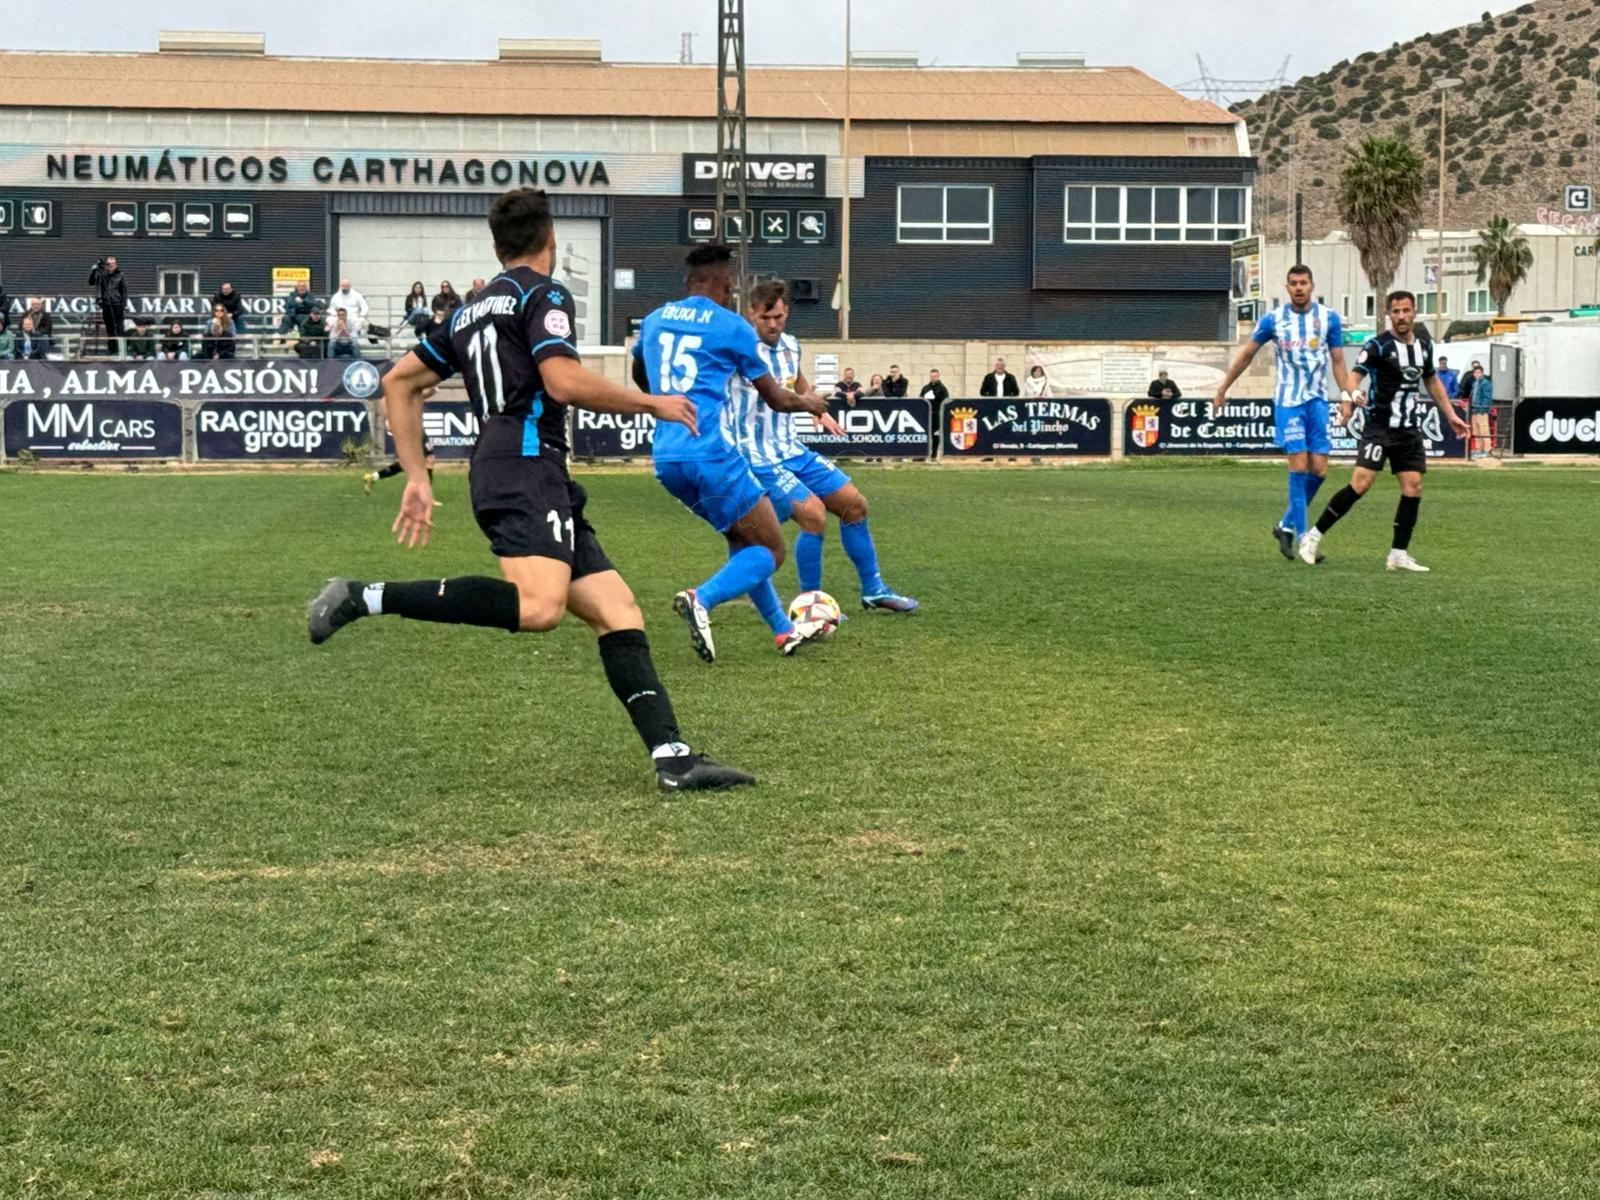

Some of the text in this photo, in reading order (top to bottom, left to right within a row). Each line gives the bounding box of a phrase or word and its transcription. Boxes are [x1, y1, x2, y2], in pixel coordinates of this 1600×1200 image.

[47, 149, 610, 185] NEUMÁTICOS CARTHAGONOVA
[1574, 246, 1599, 257] CAR
[141, 297, 195, 313] MAR
[661, 305, 696, 322] EBUKA
[467, 321, 506, 422] 11
[658, 332, 703, 393] 15
[60, 369, 171, 399] ALMA,
[180, 361, 318, 394] PASIÓN!
[578, 409, 656, 429] RACIN
[982, 402, 1101, 431] LAS TERMAS
[1171, 402, 1197, 418] El
[27, 403, 156, 438] MM CARS
[201, 410, 367, 432] RACINGCITY
[1012, 419, 1069, 435] del Pincho
[1170, 423, 1192, 438] de
[1197, 422, 1276, 438] Castilla
[244, 431, 322, 453] group
[620, 429, 656, 449] gro
[852, 434, 884, 443] SCHOOL
[885, 434, 896, 443] OF
[897, 434, 928, 443] SOCCER
[1364, 443, 1383, 462] 10
[546, 509, 575, 552] 11
